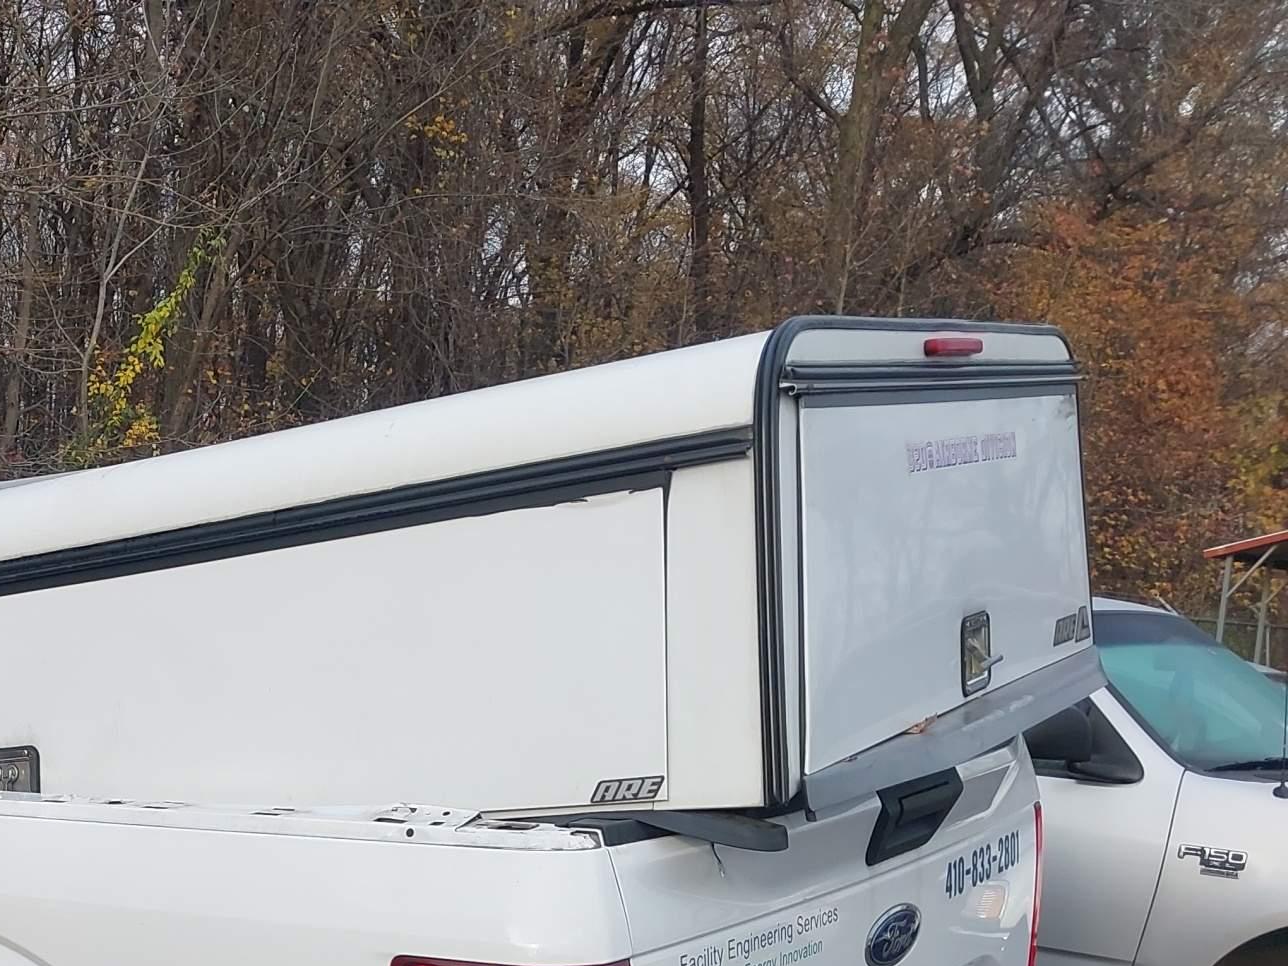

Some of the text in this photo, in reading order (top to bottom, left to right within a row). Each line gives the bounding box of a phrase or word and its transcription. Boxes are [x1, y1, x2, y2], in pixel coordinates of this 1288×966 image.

[591, 775, 665, 803] ARE
[945, 830, 1019, 899] 410-833-2801
[727, 923, 794, 960] Engineering
[796, 907, 839, 936] Services
